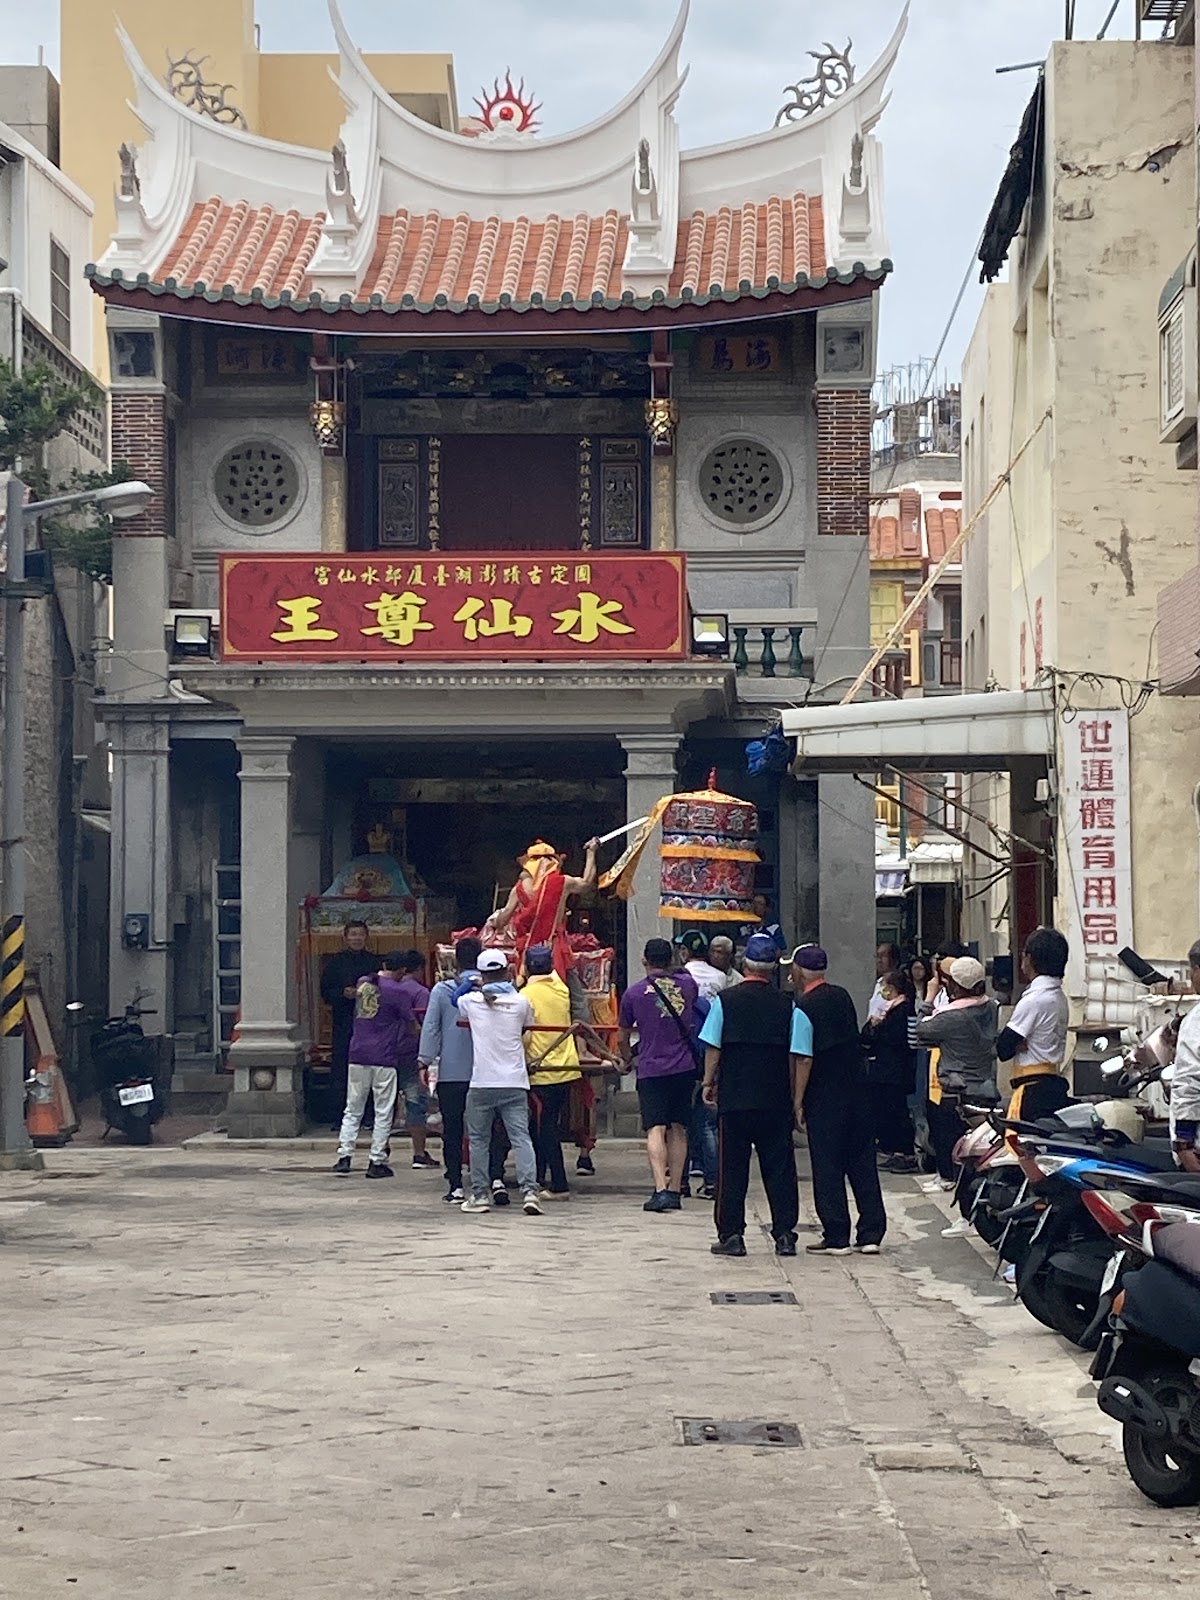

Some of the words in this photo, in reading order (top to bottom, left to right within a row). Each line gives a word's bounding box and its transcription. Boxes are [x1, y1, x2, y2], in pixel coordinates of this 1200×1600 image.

[270, 591, 636, 646] 水仙尊王
[1079, 720, 1118, 945] 世運體育用品
